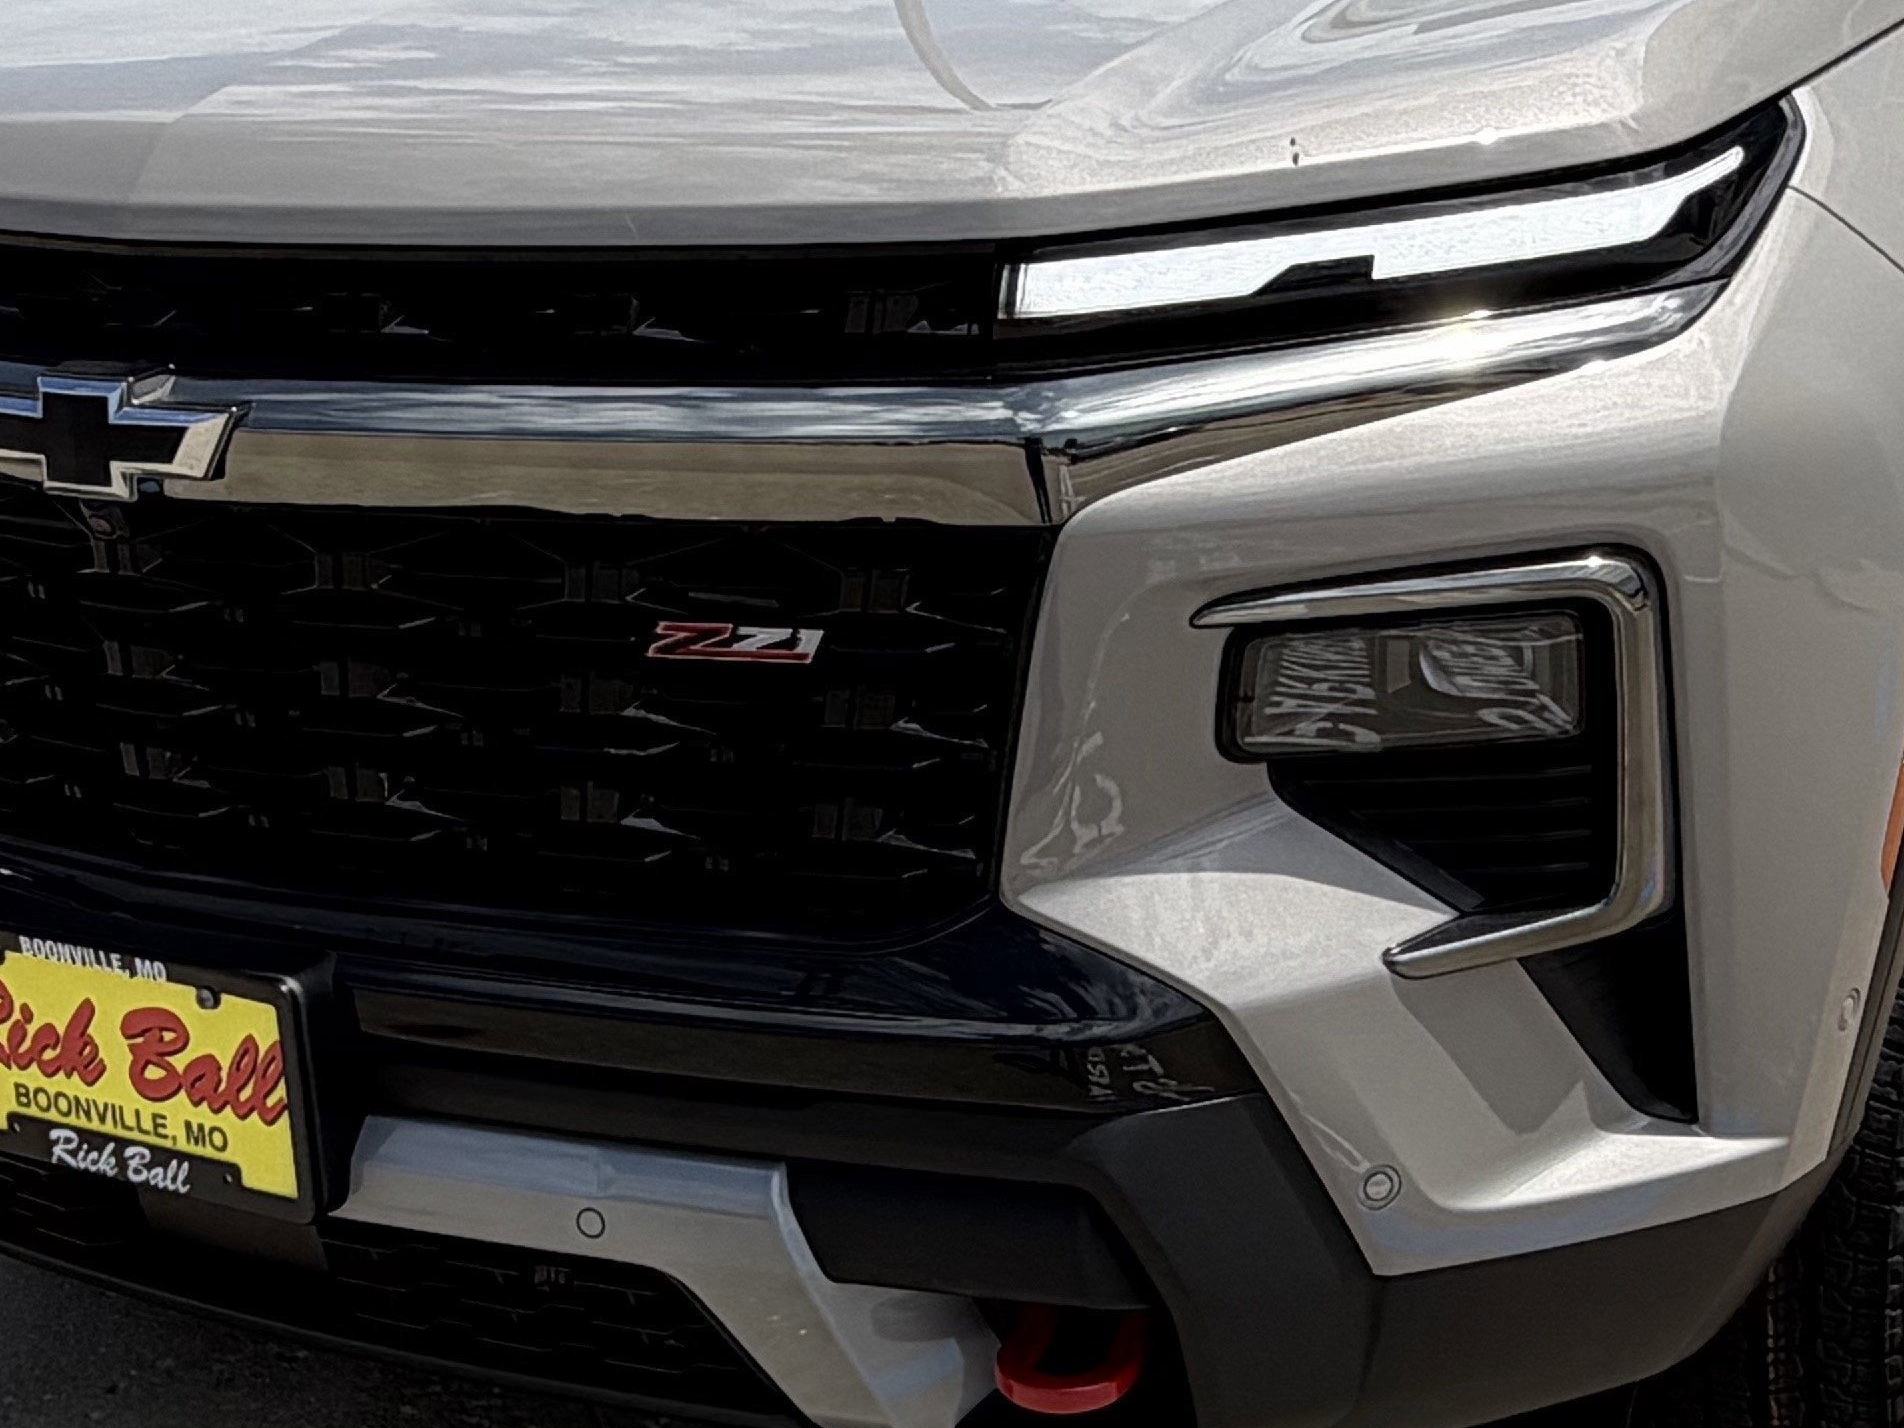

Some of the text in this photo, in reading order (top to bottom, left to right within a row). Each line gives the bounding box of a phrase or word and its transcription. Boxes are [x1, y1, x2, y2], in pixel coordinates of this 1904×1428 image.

[646, 620, 825, 664] Z71
[18, 935, 167, 983] BOONVILLE, MO
[119, 1006, 288, 1127] Ball
[13, 1082, 228, 1153] BOONVILLE, MO
[48, 1128, 191, 1194] Rick Ball
